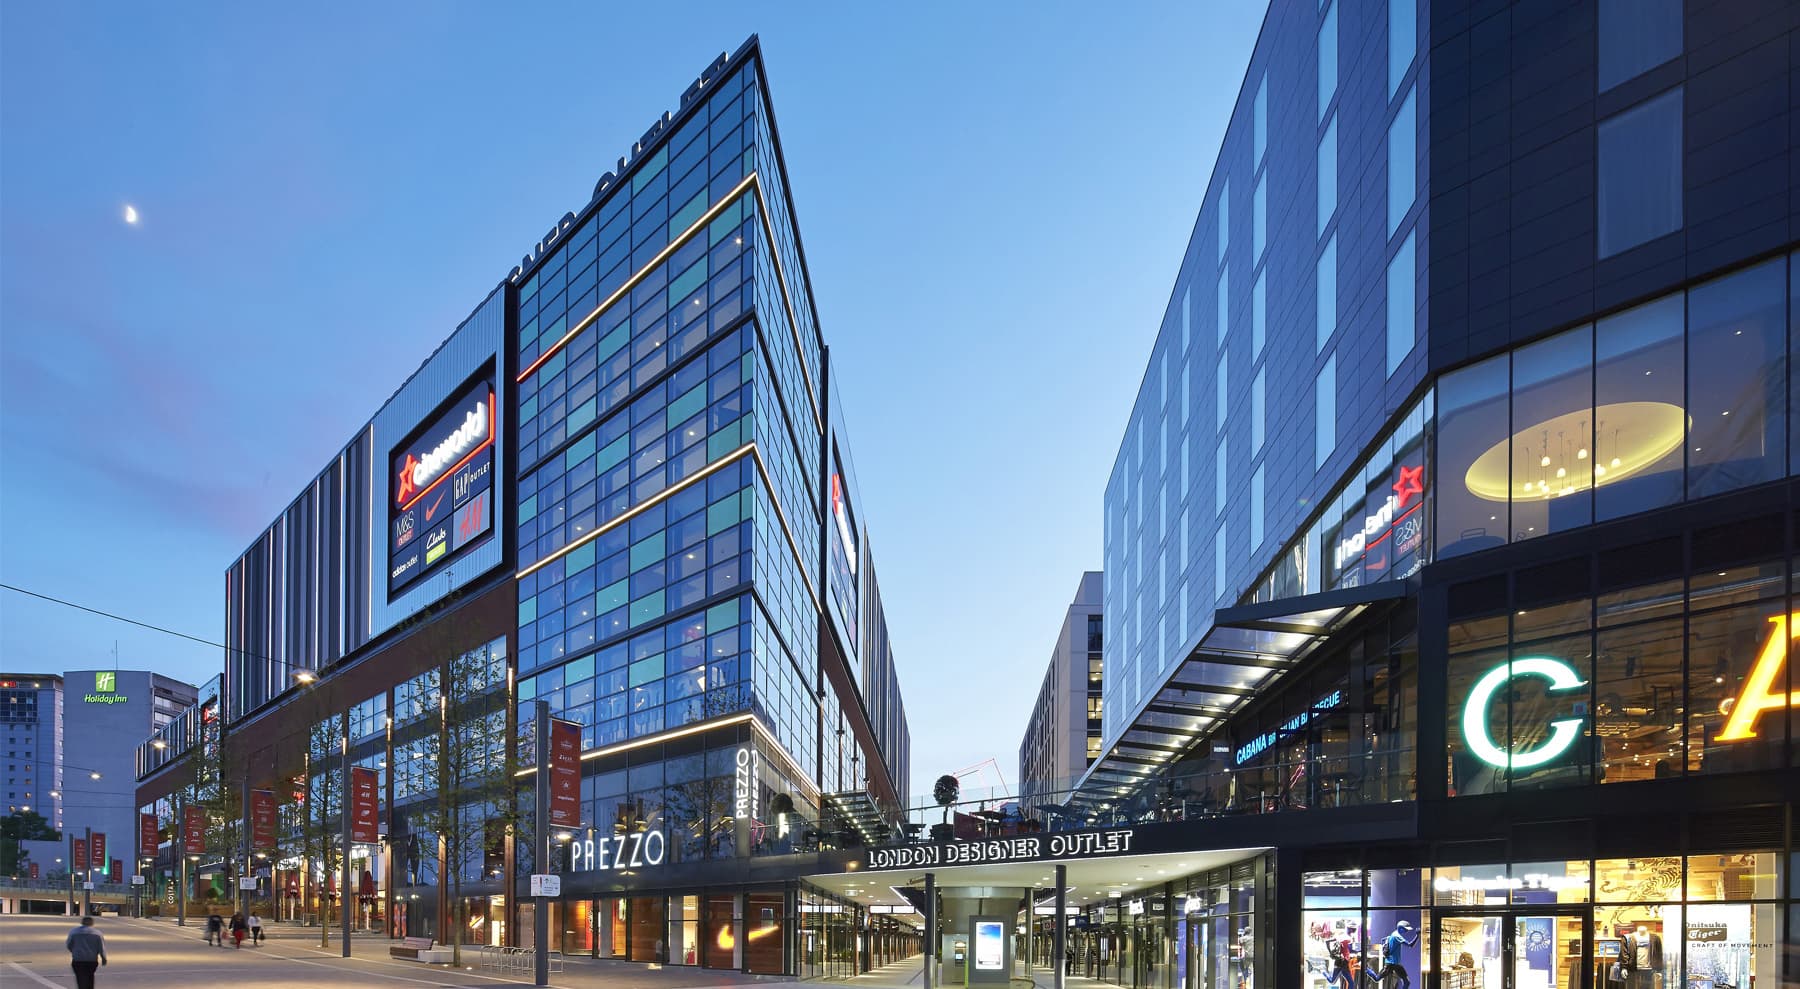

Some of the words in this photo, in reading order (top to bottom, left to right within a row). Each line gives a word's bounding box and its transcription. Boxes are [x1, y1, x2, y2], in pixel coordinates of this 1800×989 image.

[455, 473, 468, 500] GAP
[470, 462, 491, 483] OUTLET
[396, 510, 415, 538] M&S
[84, 694, 113, 705] Holiday
[114, 694, 128, 703] Inn
[1236, 734, 1267, 765] CABANA
[736, 748, 749, 819] PREZZO
[572, 831, 664, 873] PREZZO
[868, 846, 939, 868] LONDON
[945, 838, 1040, 863] DESIGNER
[1050, 830, 1133, 856] OUTLET
